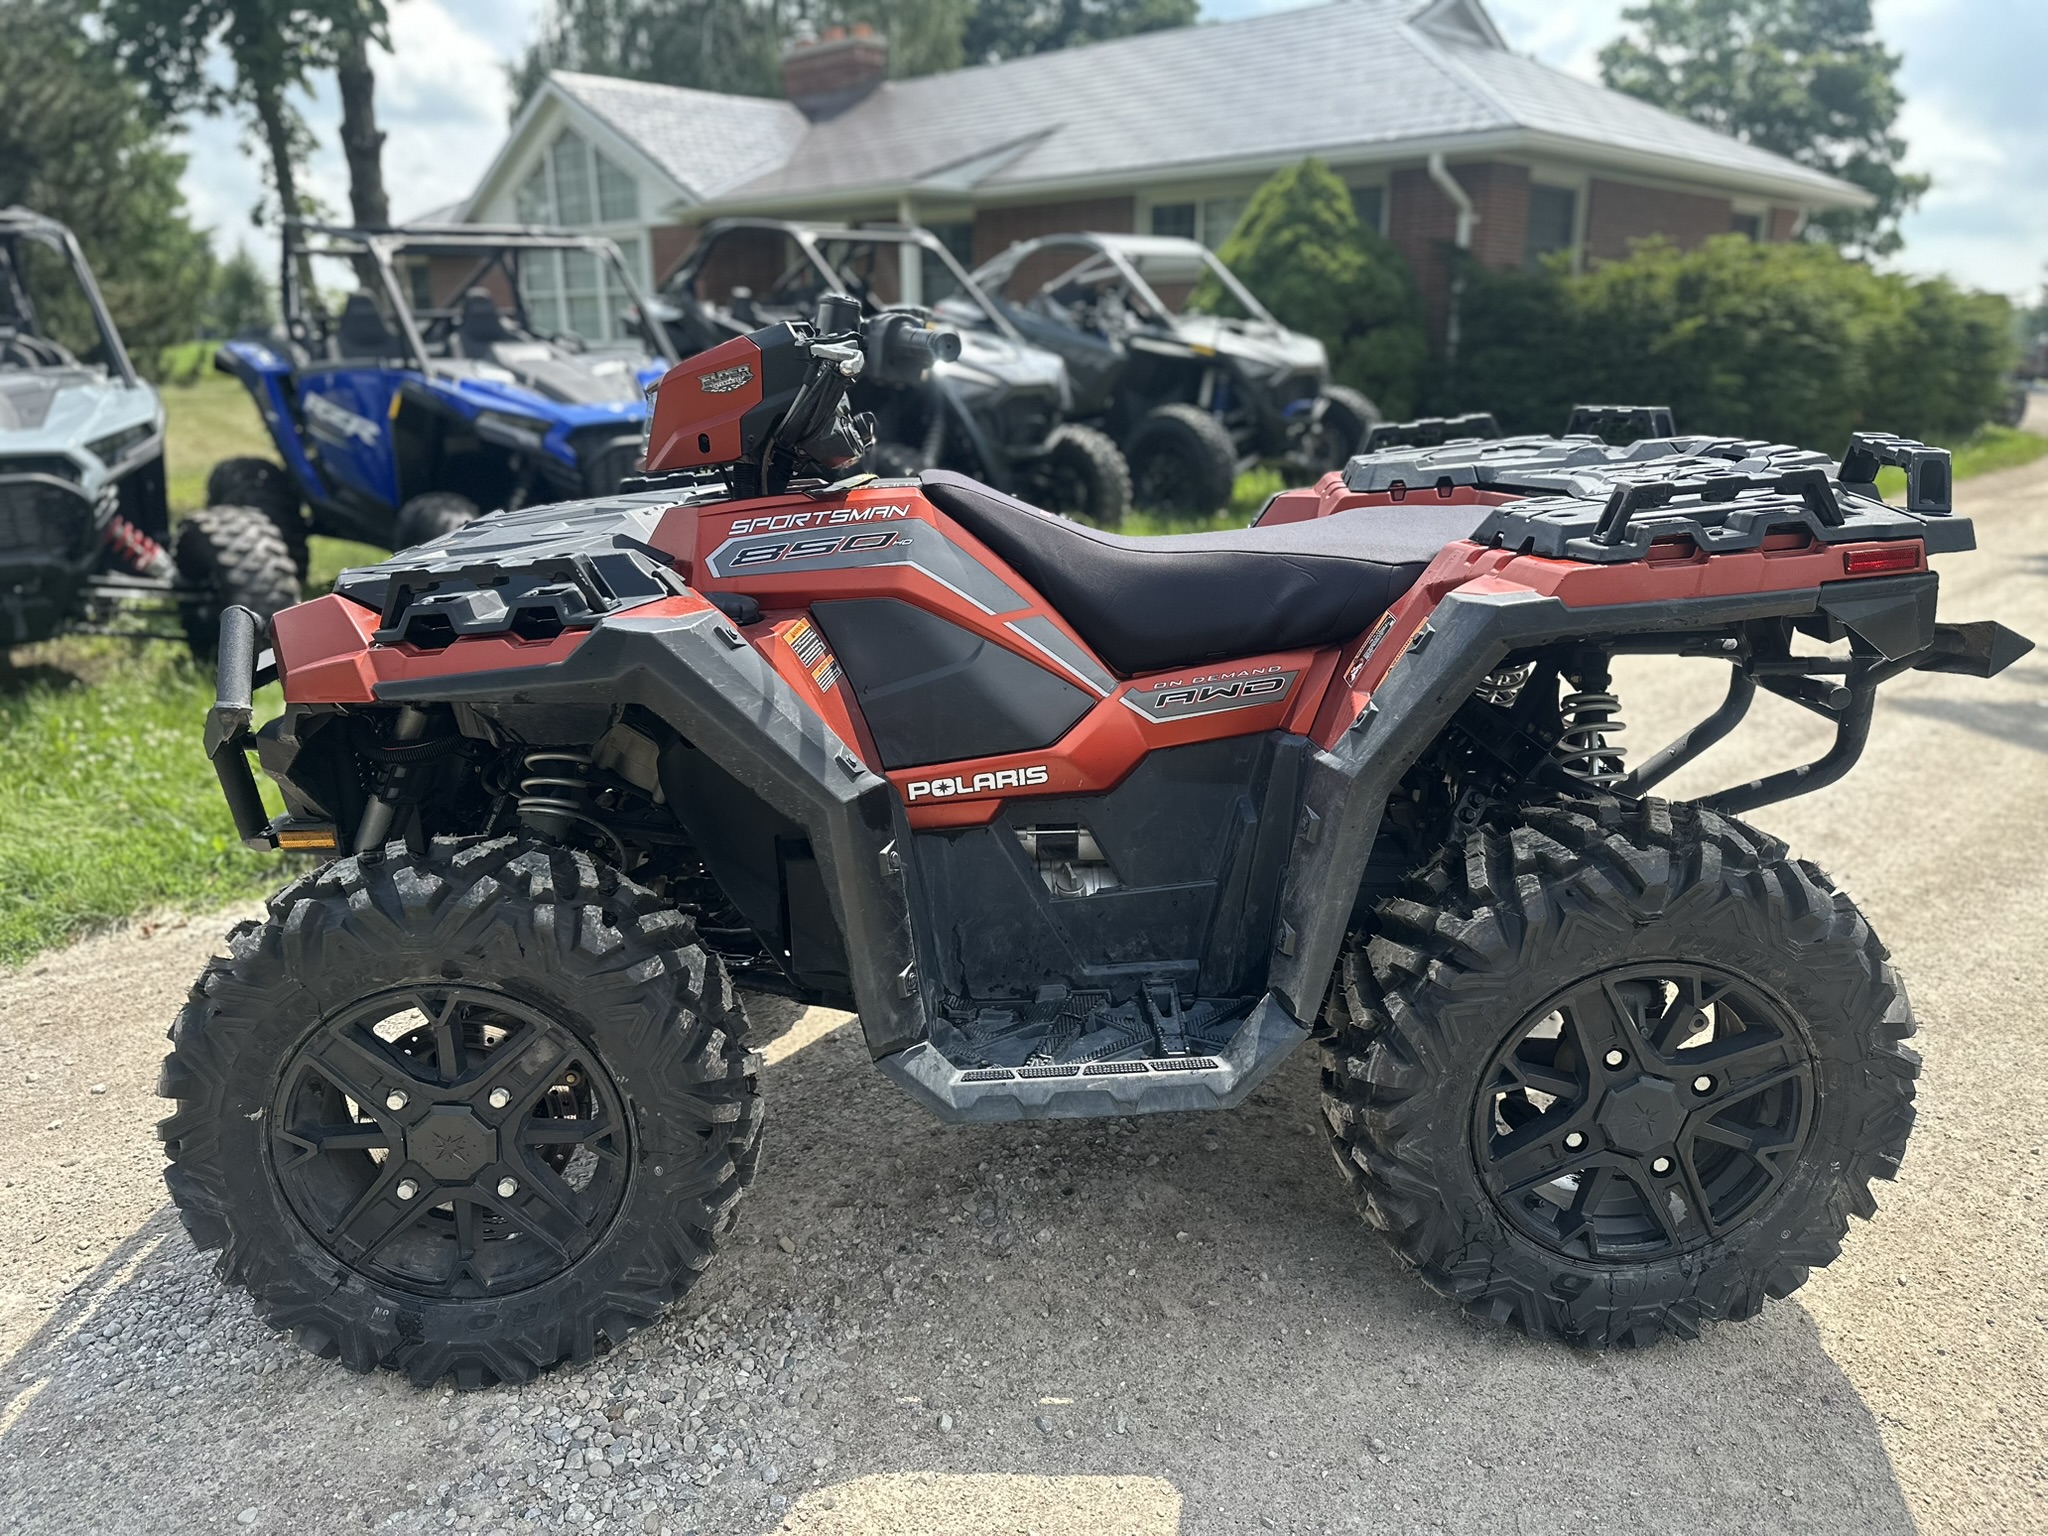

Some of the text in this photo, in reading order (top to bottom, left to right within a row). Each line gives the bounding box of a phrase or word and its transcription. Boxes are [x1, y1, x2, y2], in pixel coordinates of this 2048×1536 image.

[728, 504, 911, 536] SPORTSMAN
[729, 531, 899, 568] 850
[1153, 665, 1282, 690] ON DEMAND
[1154, 676, 1286, 709] AWD
[907, 765, 1049, 801] POLARIS
